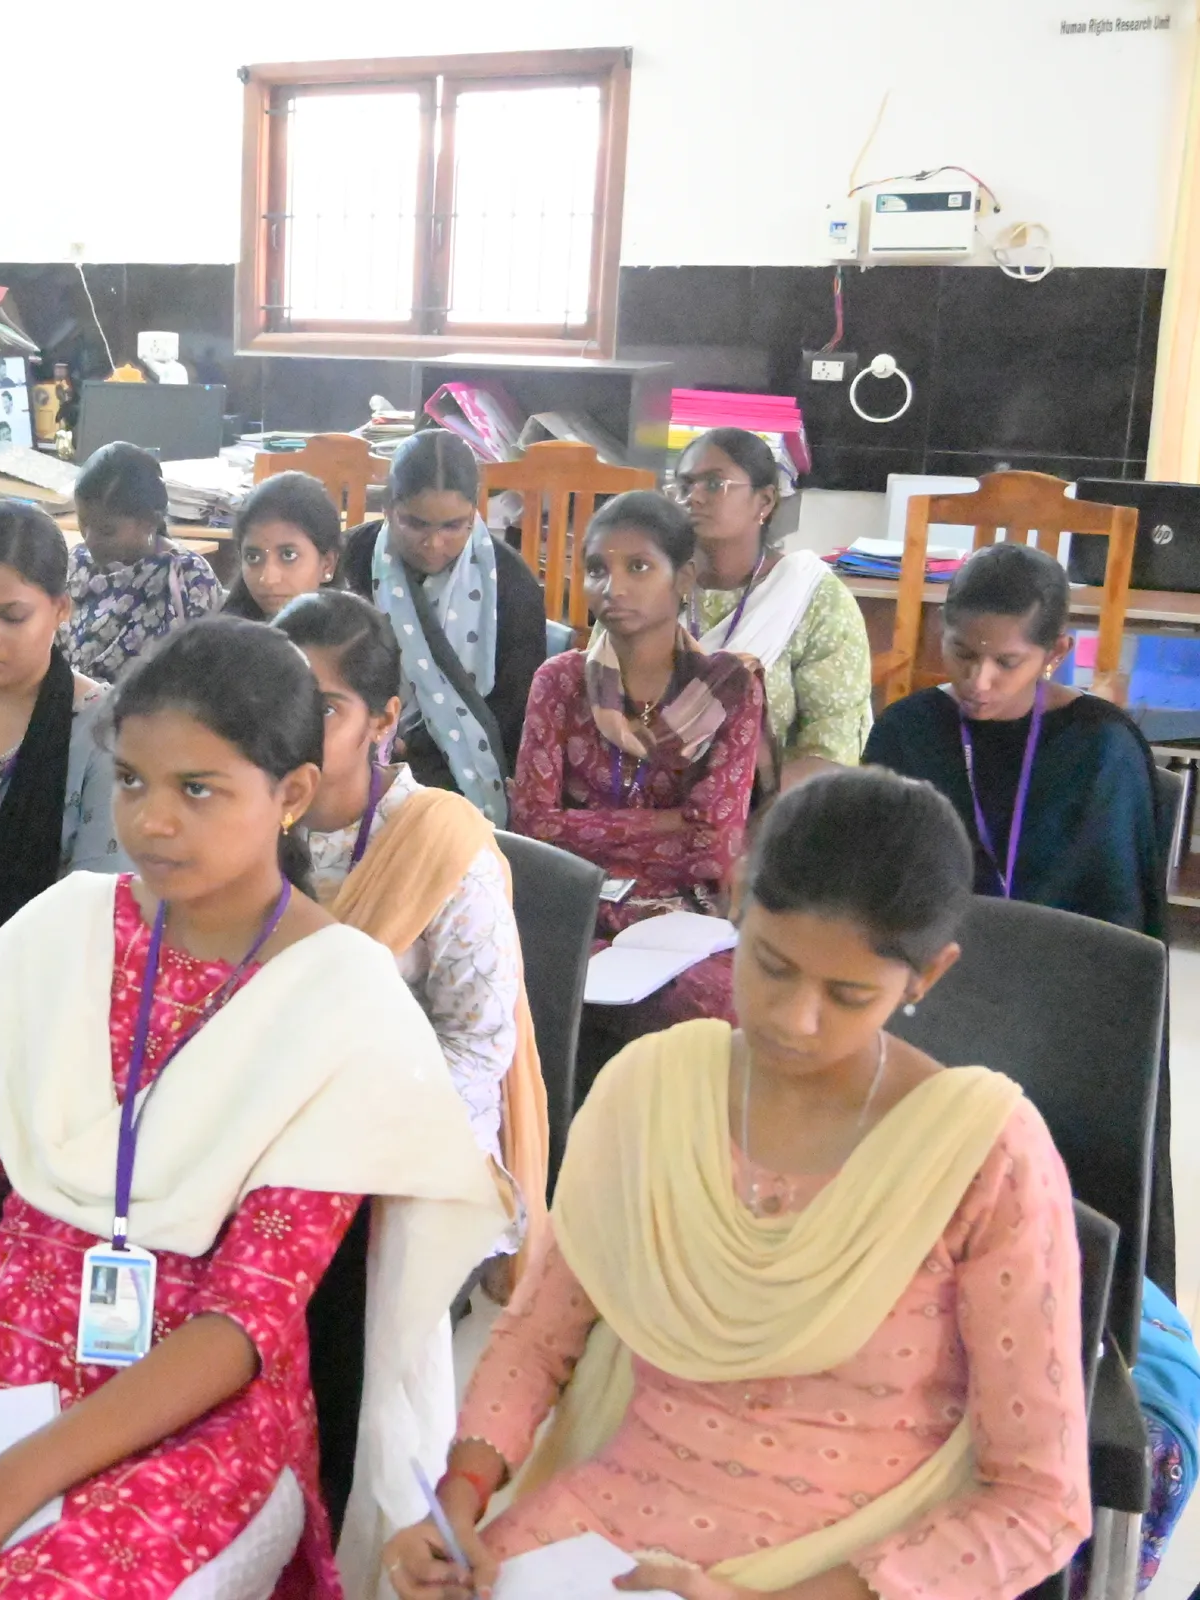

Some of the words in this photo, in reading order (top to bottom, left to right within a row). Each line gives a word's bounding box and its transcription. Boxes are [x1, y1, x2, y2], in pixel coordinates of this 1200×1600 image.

[1060, 20, 1087, 35] Human
[1088, 18, 1113, 36] Rights
[1115, 17, 1152, 32] Research
[1152, 524, 1173, 545] hp
